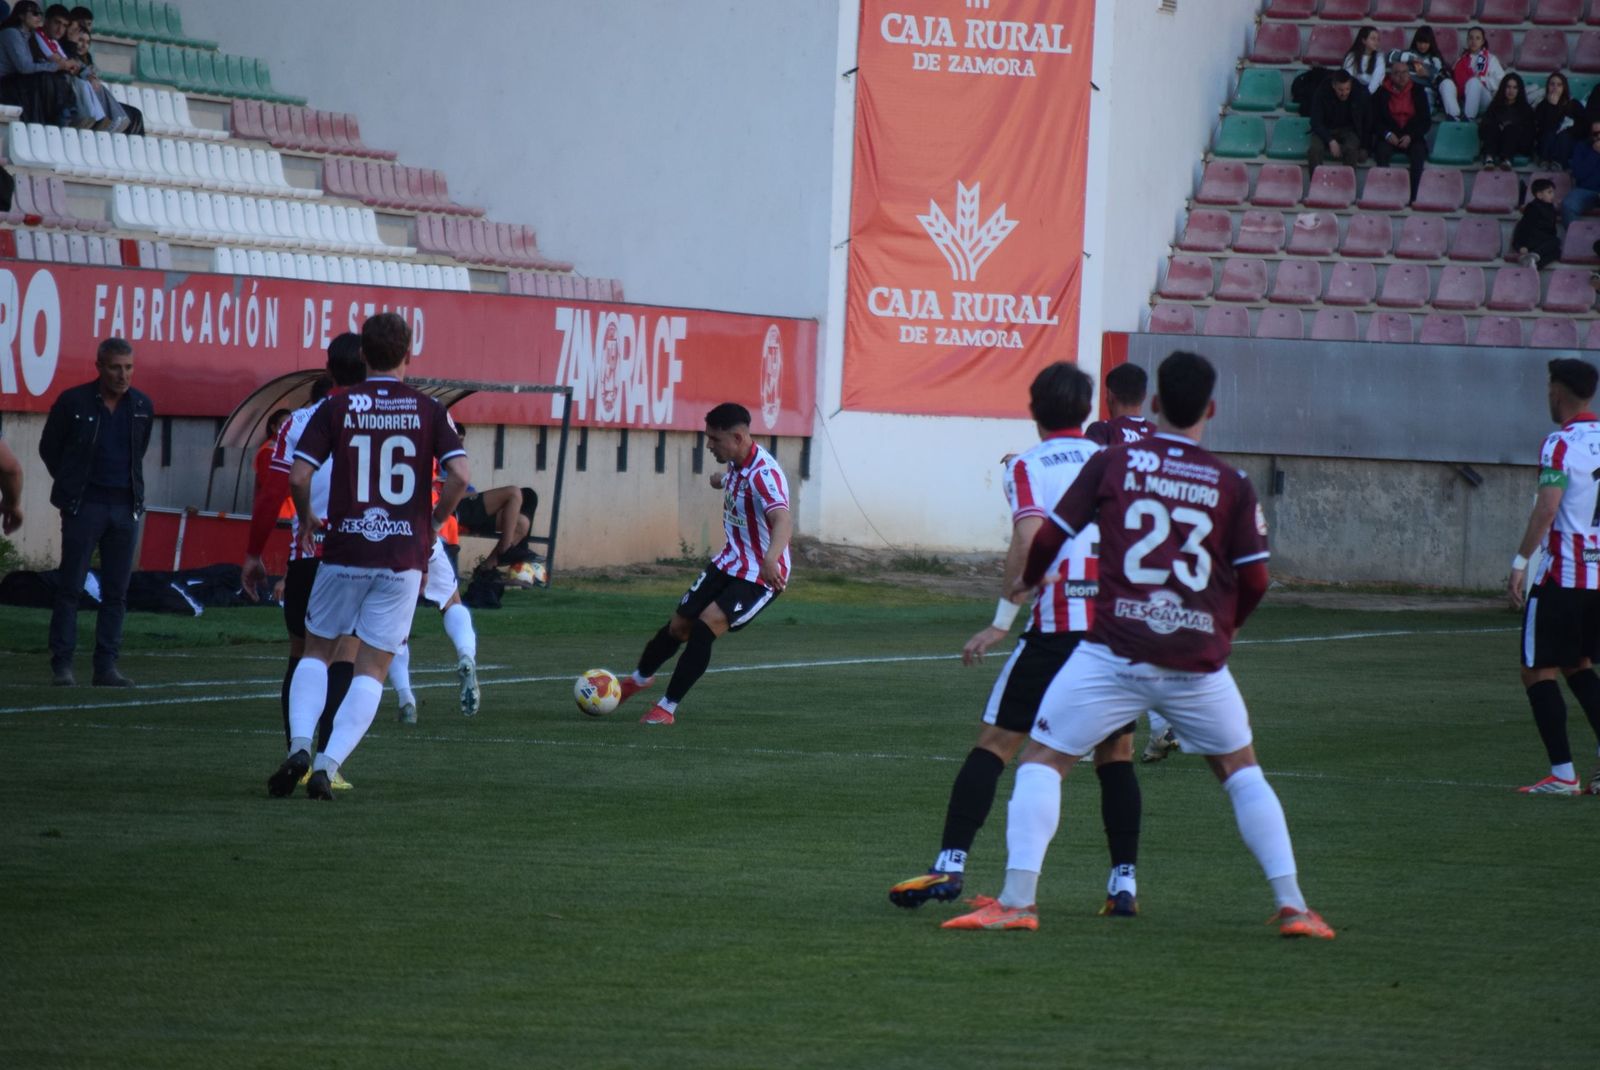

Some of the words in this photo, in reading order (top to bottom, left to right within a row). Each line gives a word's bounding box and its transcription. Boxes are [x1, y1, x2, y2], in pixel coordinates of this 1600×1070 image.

[880, 13, 957, 48] CAJA
[964, 19, 1072, 54] RURAL
[912, 52, 941, 72] DE
[947, 55, 1037, 77] ZAMORA
[93, 281, 279, 349] FABRICACIÓN
[303, 298, 333, 350] DE
[867, 286, 944, 320] CAJA
[951, 292, 1059, 325] RURAL
[898, 325, 928, 344] DE
[935, 328, 1025, 348] ZAMORA
[551, 307, 651, 425] ZAMORA
[652, 316, 687, 425] CF
[343, 413, 356, 429] A.
[357, 413, 421, 430] VIDORRETA
[349, 434, 417, 505] 16
[1123, 471, 1142, 492] A.
[1144, 475, 1220, 509] MONTORO
[1123, 498, 1214, 592] 23
[1115, 598, 1215, 634] PESCAMAR
